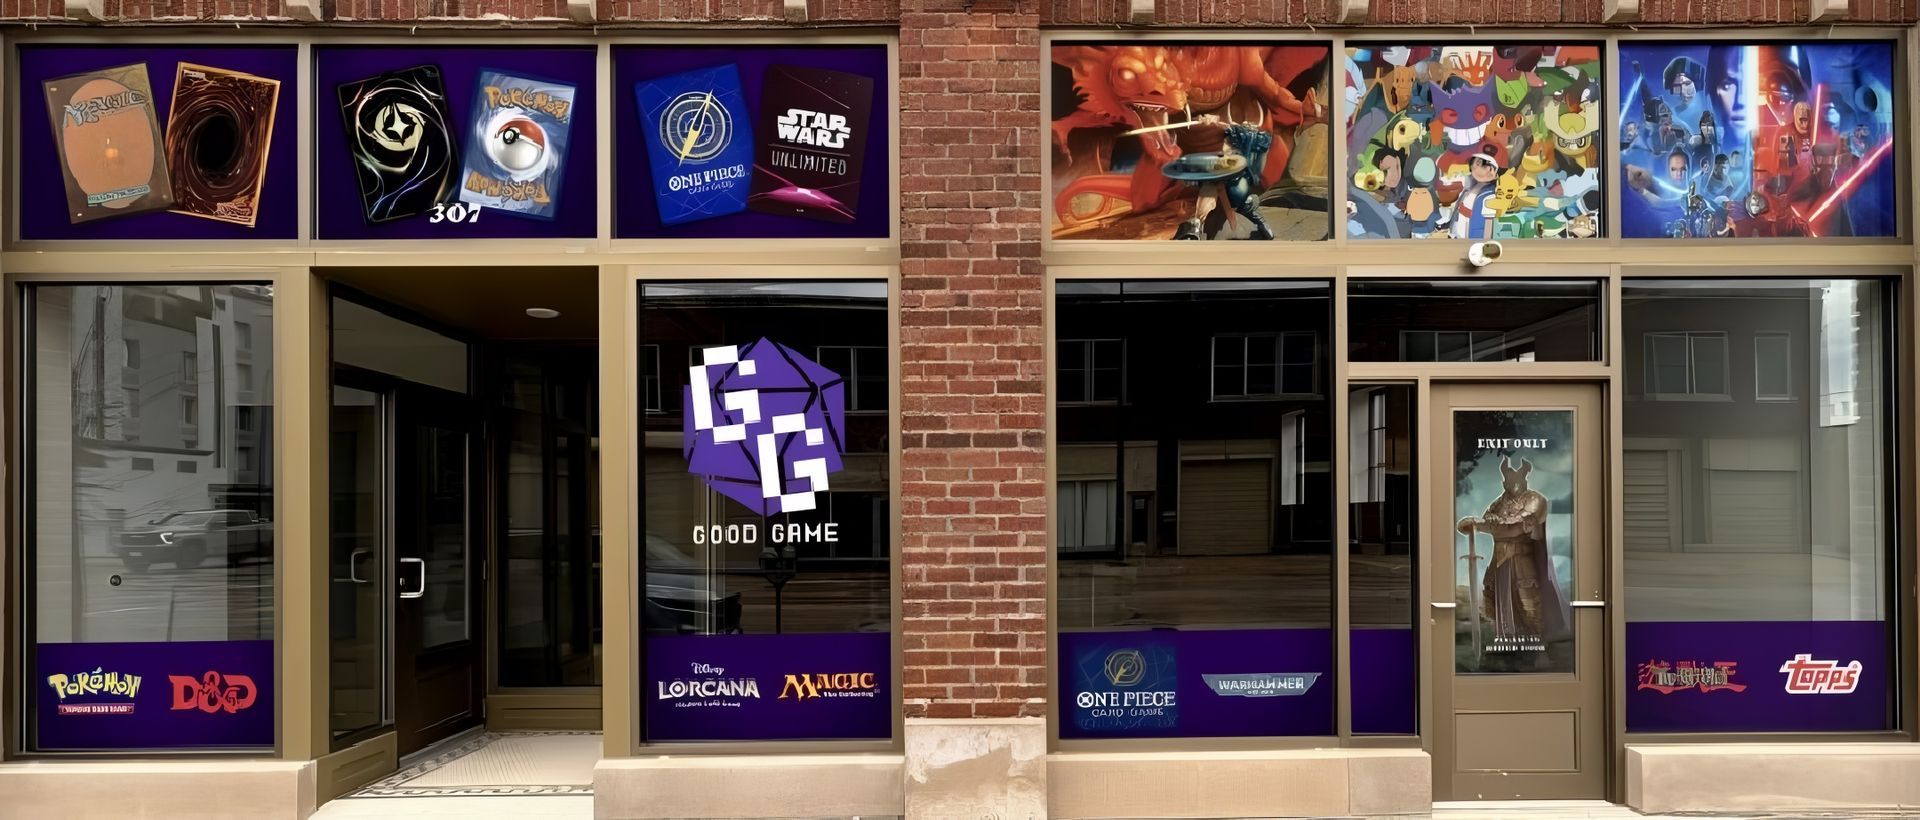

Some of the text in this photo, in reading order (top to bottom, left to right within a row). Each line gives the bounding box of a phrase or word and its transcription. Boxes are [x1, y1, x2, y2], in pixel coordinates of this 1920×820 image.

[777, 108, 852, 134] STAR
[777, 123, 851, 149] WARS
[771, 150, 847, 176] UNLIMITED
[429, 203, 482, 223] 307
[693, 523, 839, 544] GOOD GAME
[168, 670, 258, 714] D&D
[658, 680, 761, 700] LORCANA
[777, 672, 875, 701] MAGIC
[1077, 691, 1176, 708] ONE PIECE
